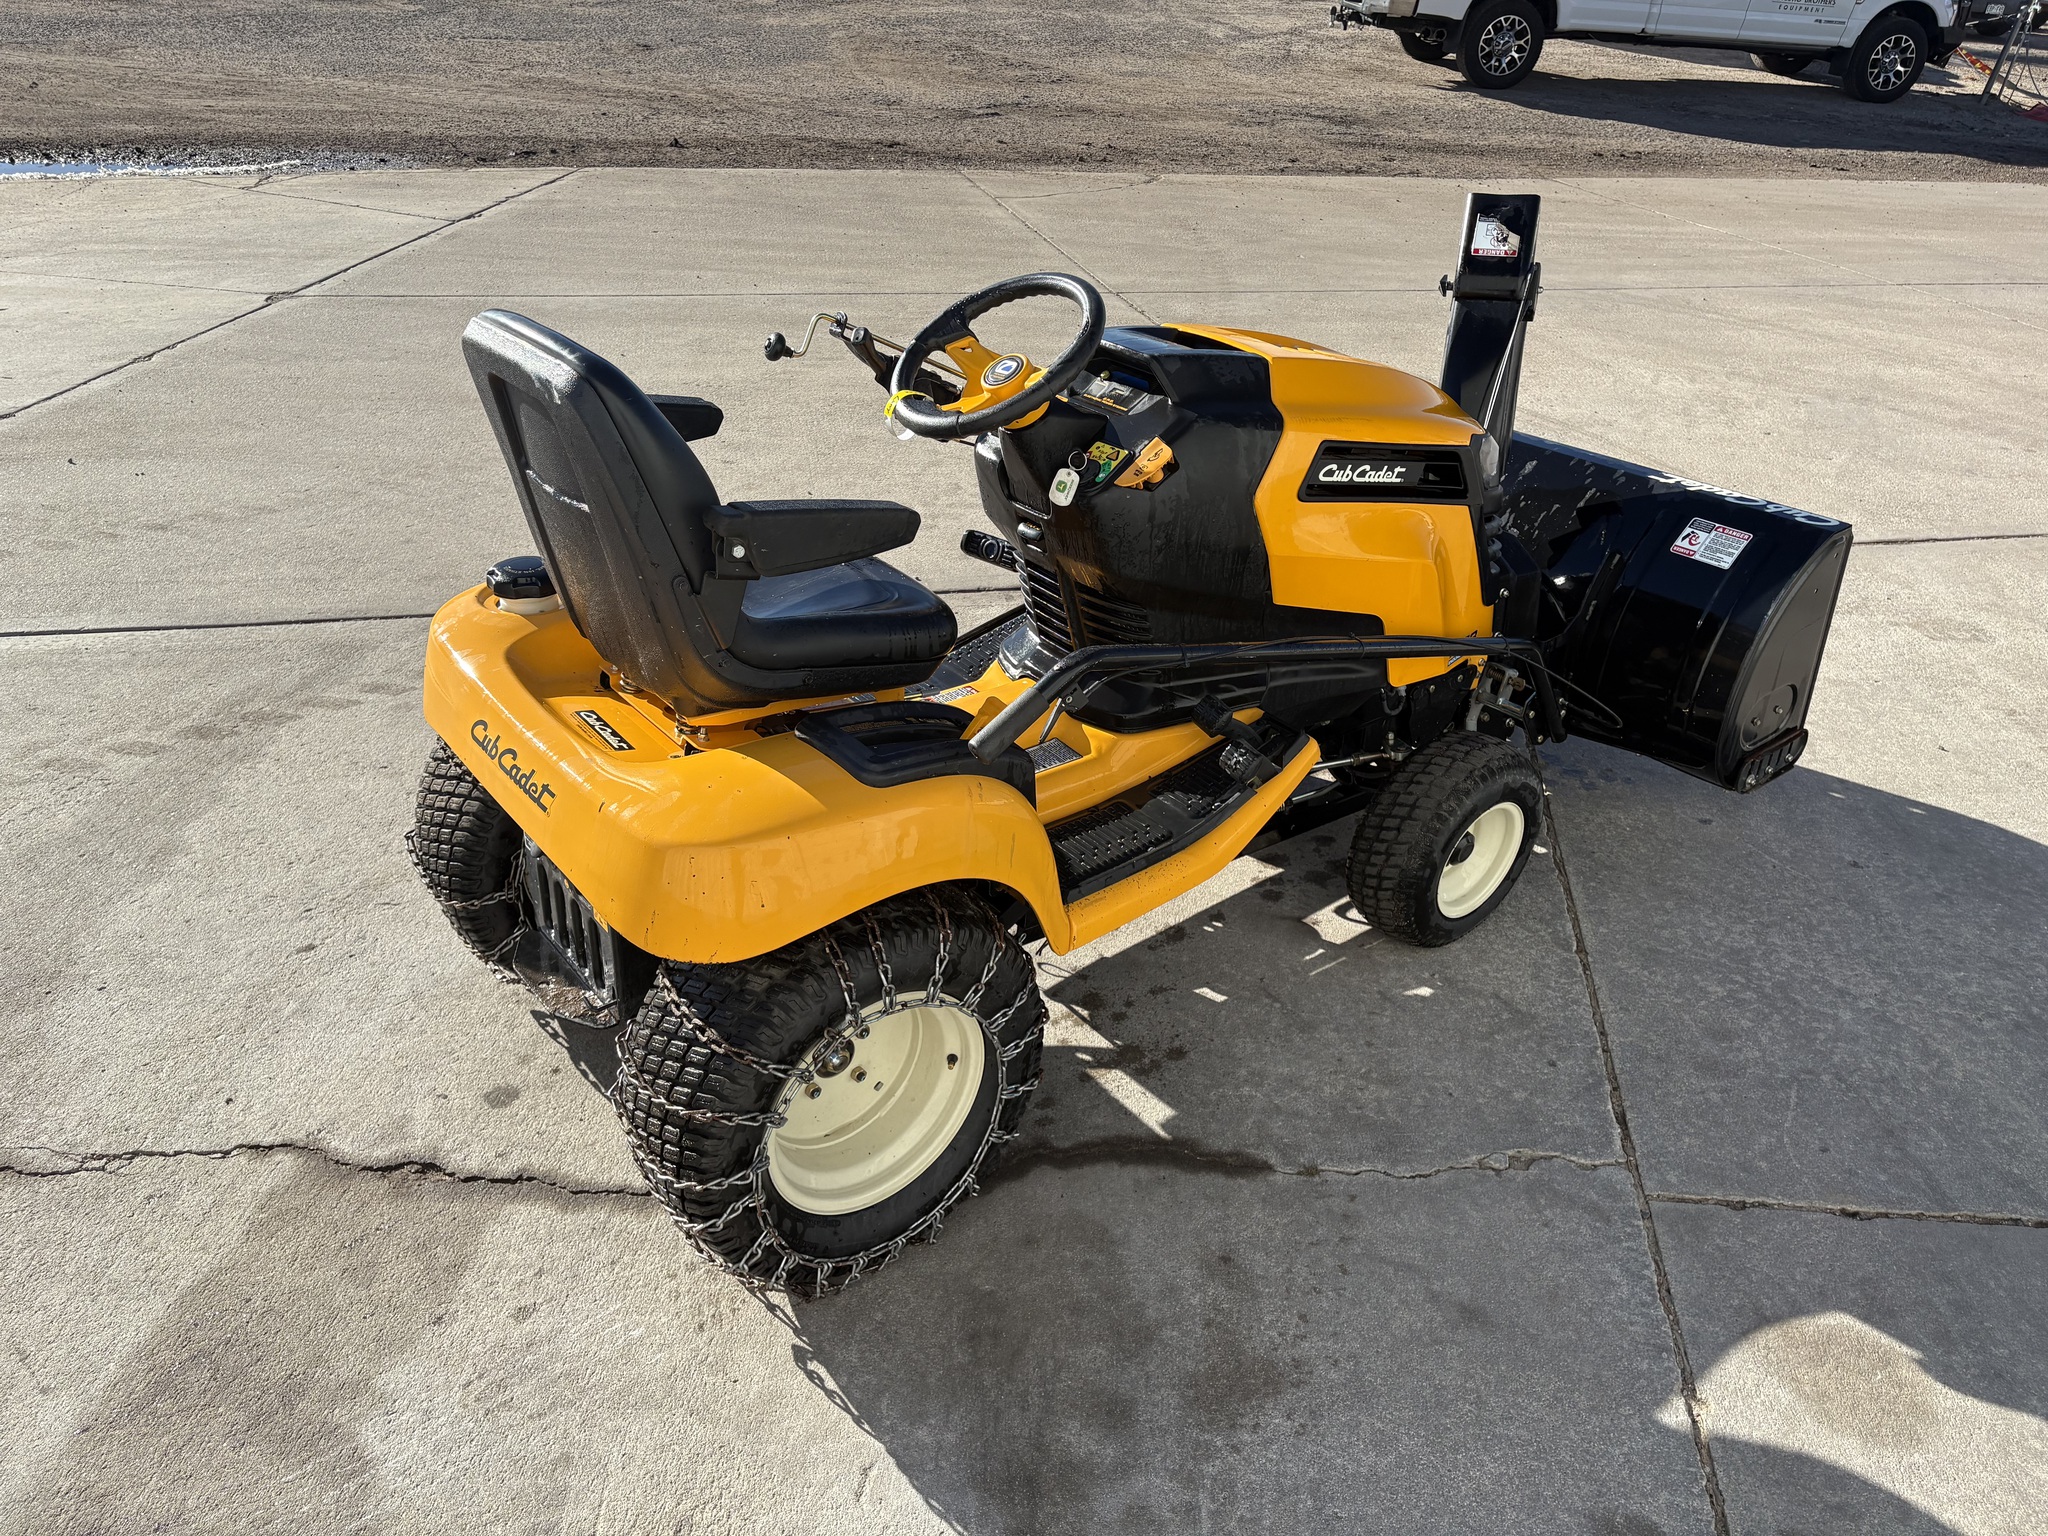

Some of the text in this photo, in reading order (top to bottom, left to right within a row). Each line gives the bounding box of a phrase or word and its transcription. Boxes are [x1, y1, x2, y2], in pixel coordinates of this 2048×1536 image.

[1778, 4, 1825, 13] EQUIPMENT
[1318, 463, 1407, 482] Cub Cadet
[1724, 529, 1750, 540] DANGER
[580, 711, 604, 726] Cub
[594, 725, 629, 749] Cadet
[470, 719, 556, 813] Cub Cadet
